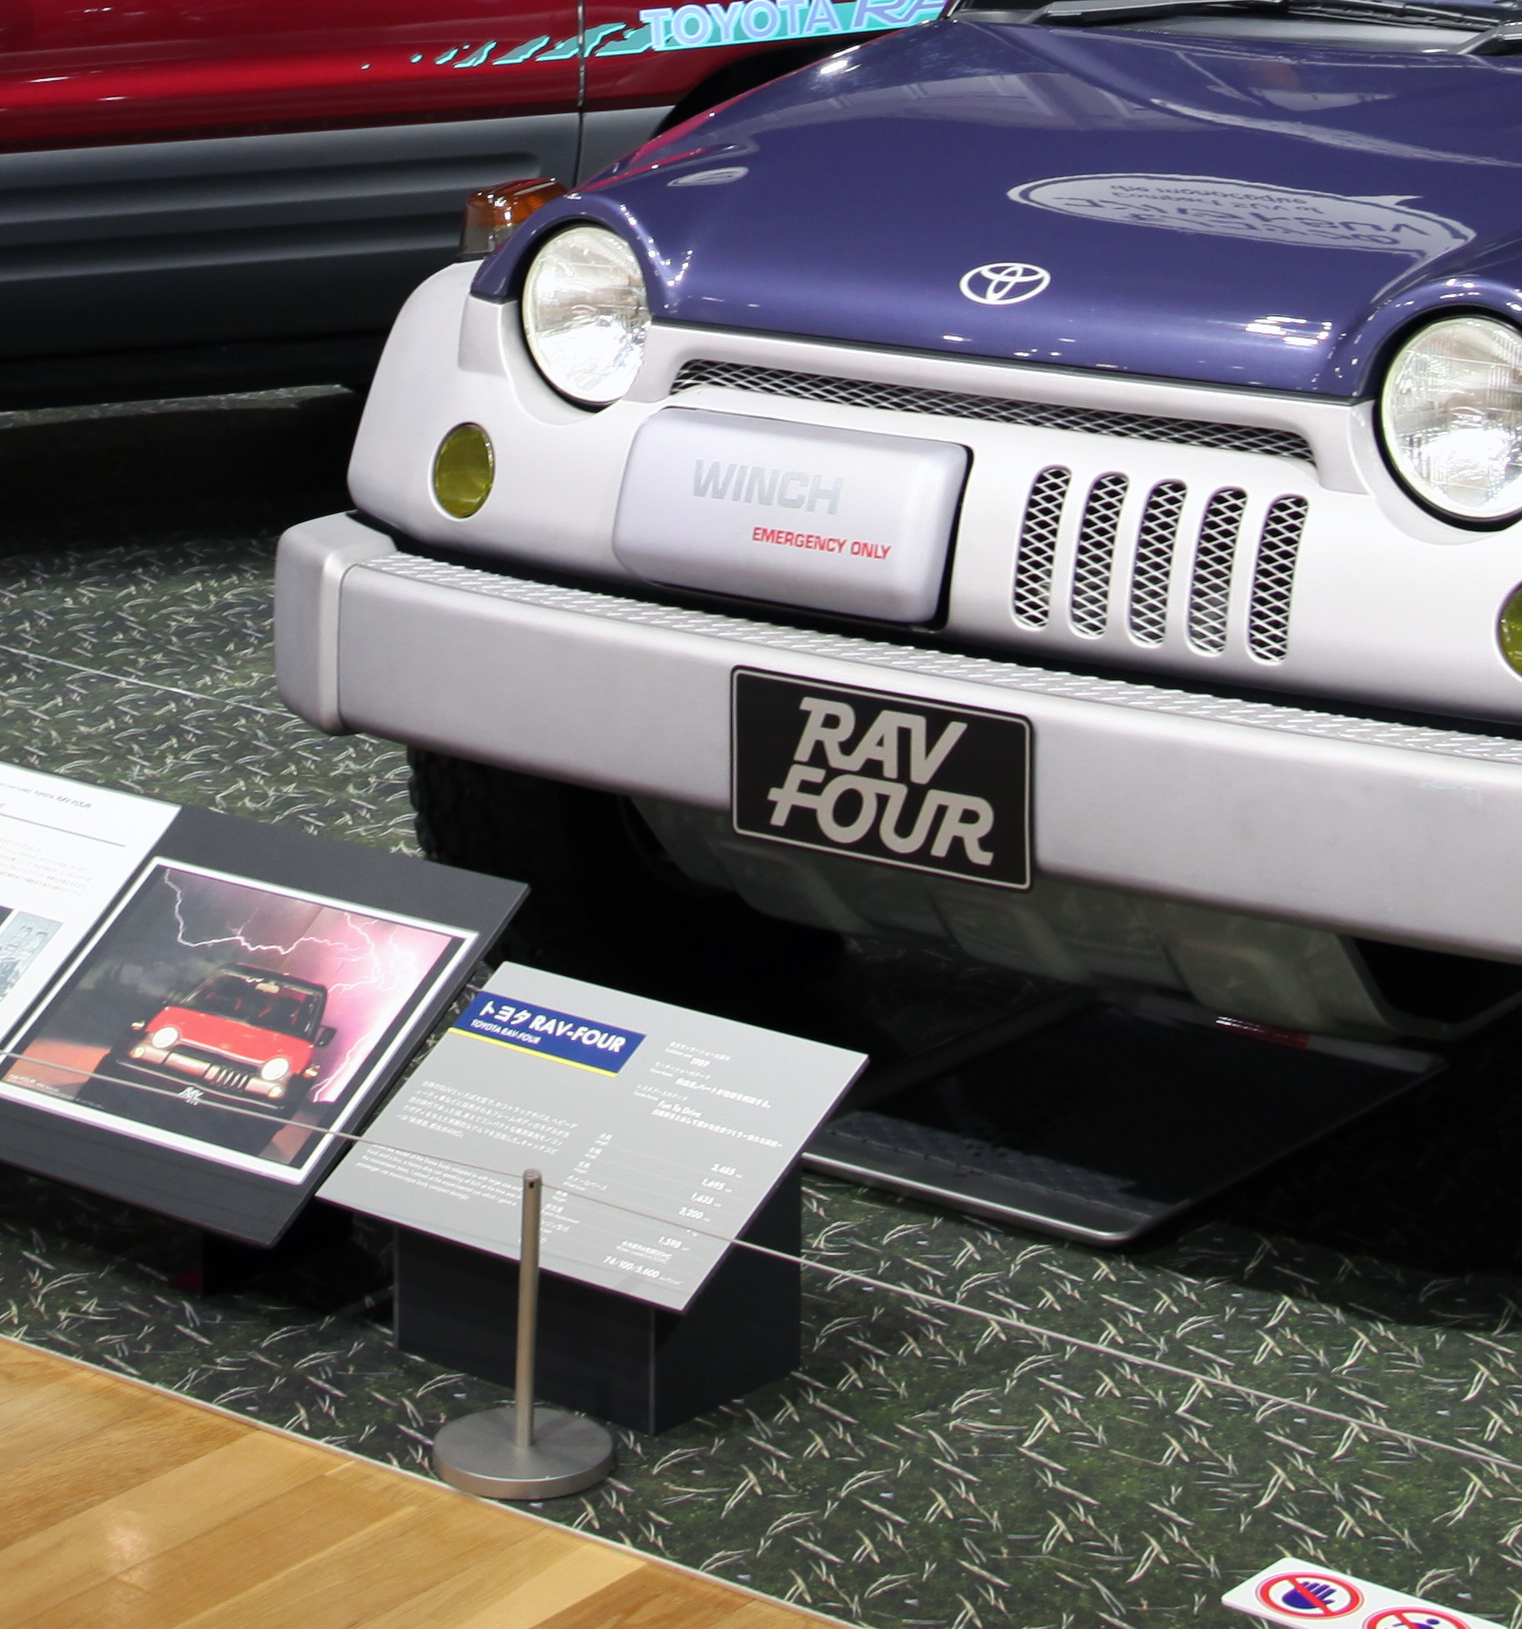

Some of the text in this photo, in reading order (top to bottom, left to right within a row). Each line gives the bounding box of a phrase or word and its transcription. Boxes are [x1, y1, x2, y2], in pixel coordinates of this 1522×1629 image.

[693, 460, 846, 515] WINCH
[751, 527, 891, 560] EMERGENCY ONLY
[794, 696, 967, 785] RAV
[768, 766, 996, 866] FOUR
[470, 1019, 541, 1045] TOYOTA RAV-FOUR
[479, 1002, 627, 1053] トヨタ RAV-FOUR
